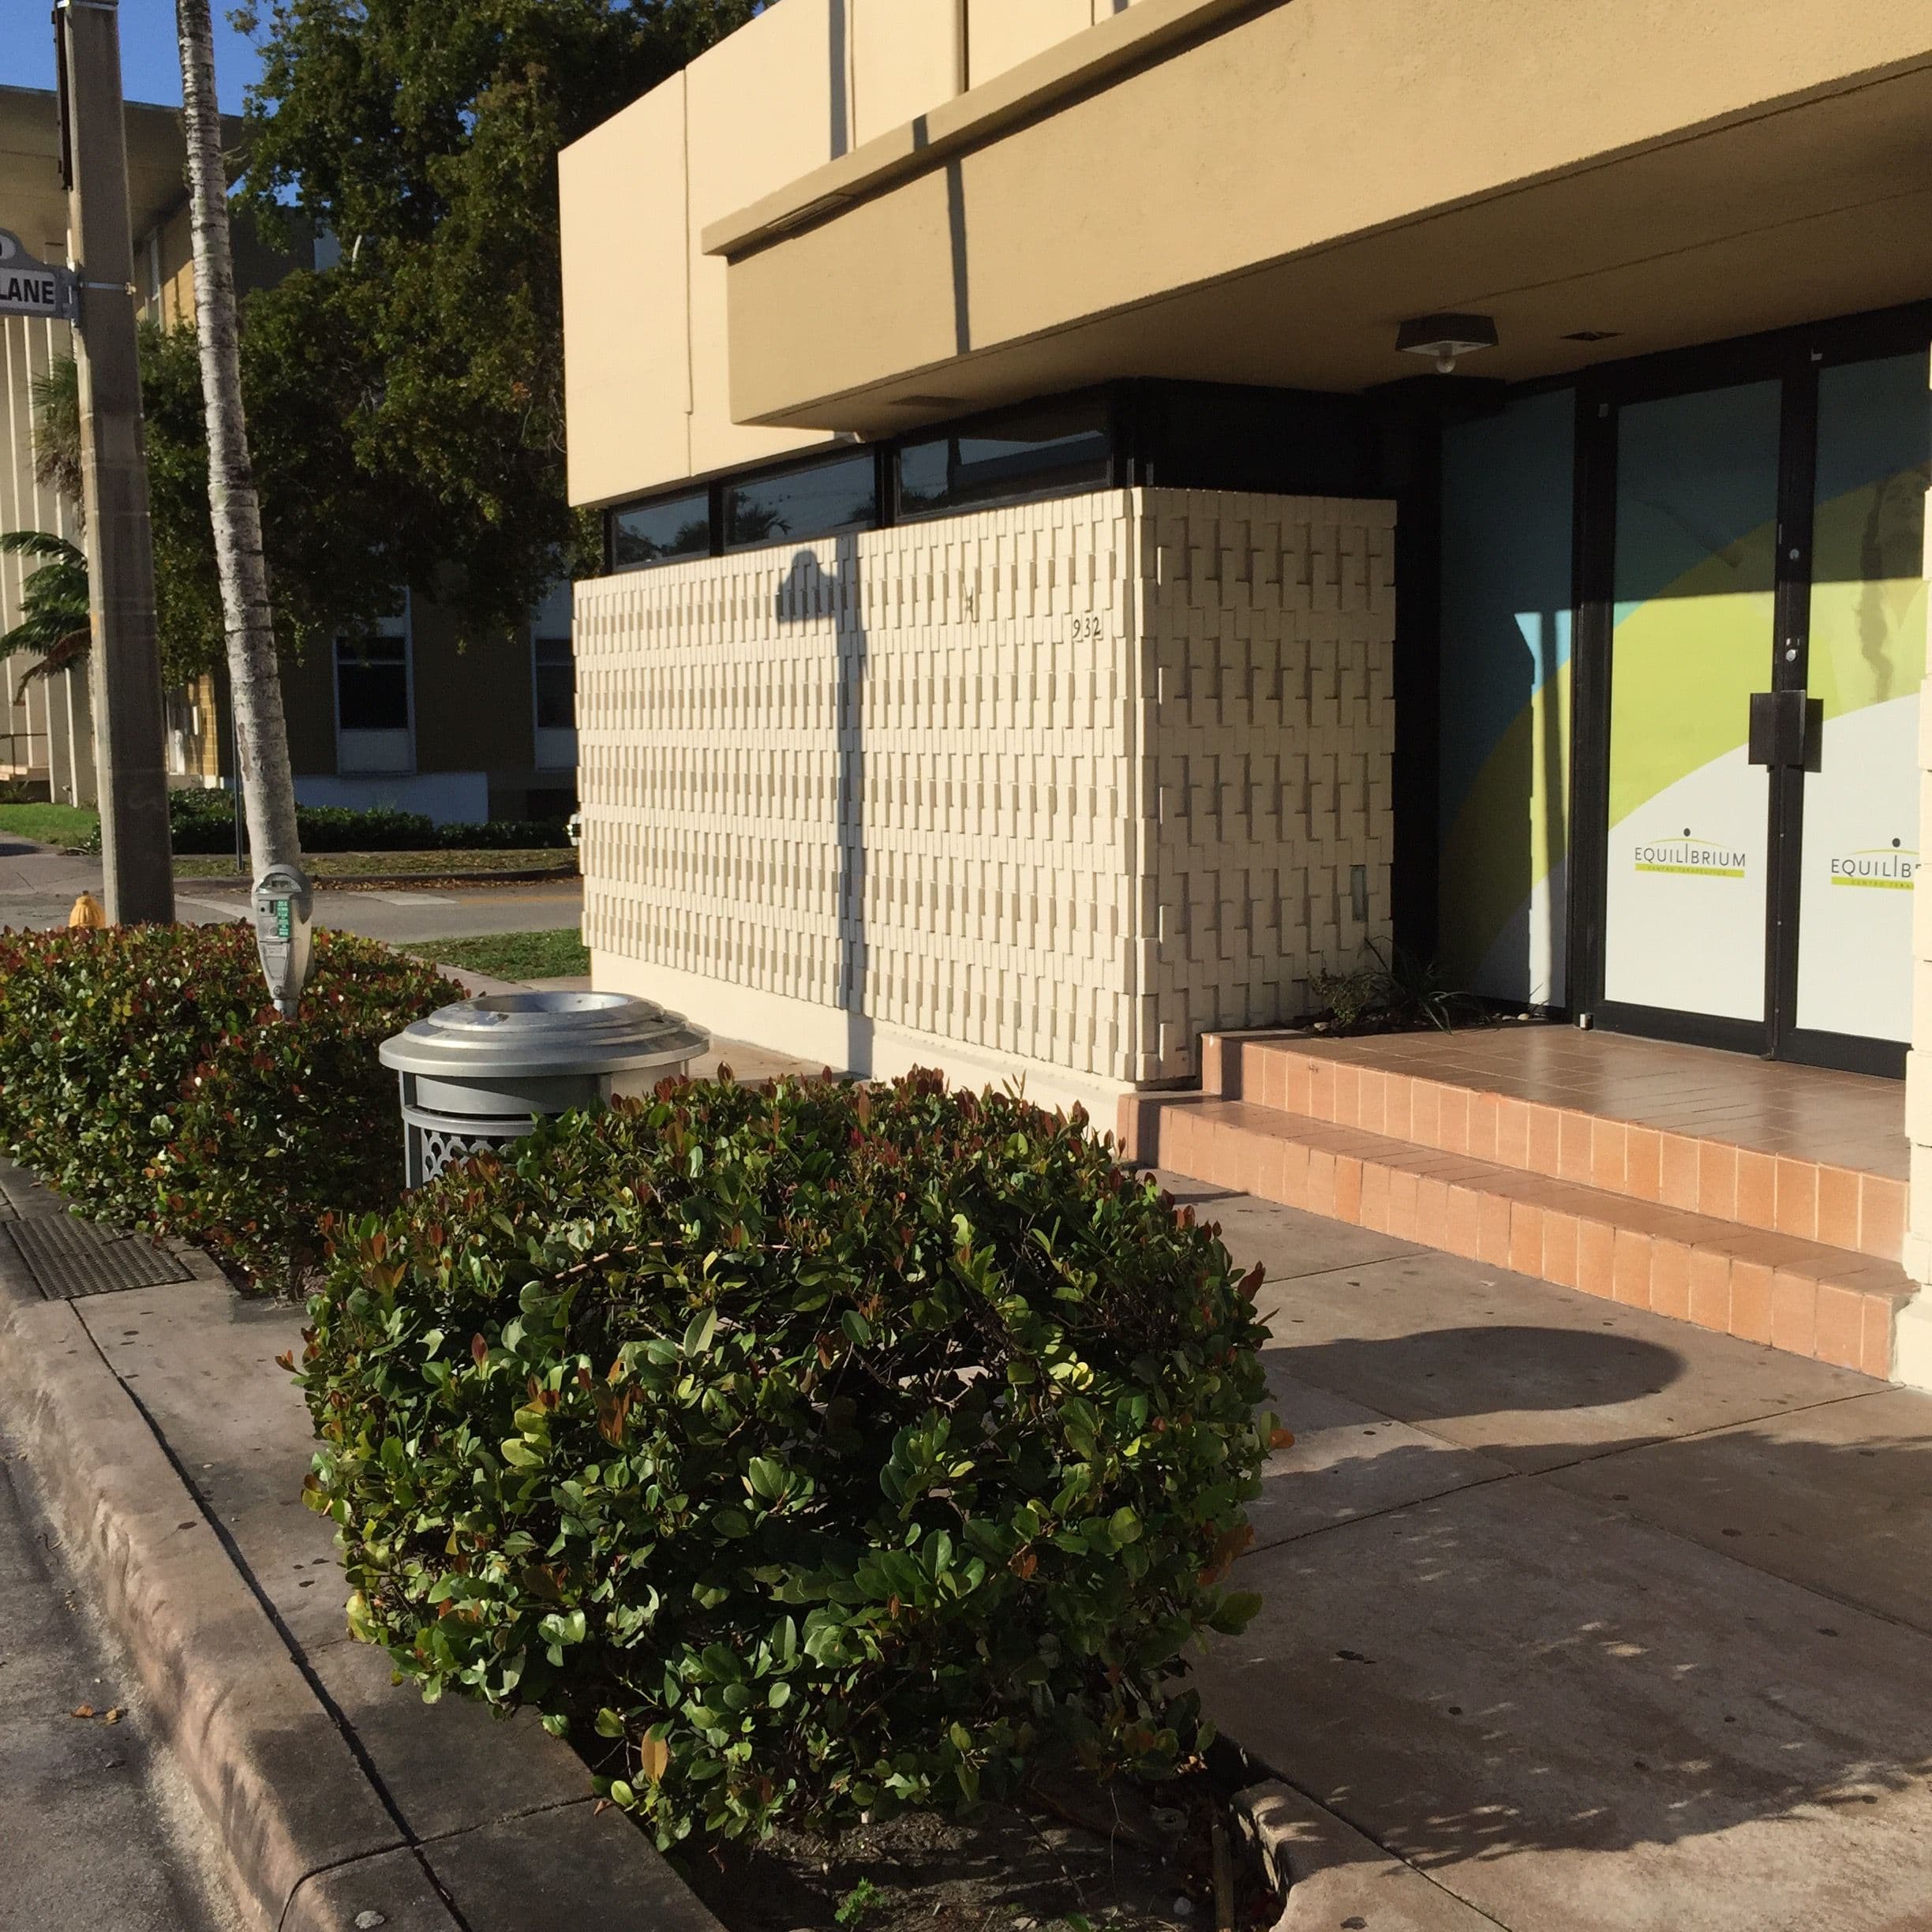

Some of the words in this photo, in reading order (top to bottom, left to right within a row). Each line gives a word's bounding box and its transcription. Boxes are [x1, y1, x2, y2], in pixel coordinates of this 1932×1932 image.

[1073, 616, 1101, 638] 932
[1634, 843, 1746, 867] EQUILIBRIUM
[1831, 855, 1921, 878] EQUILIB
